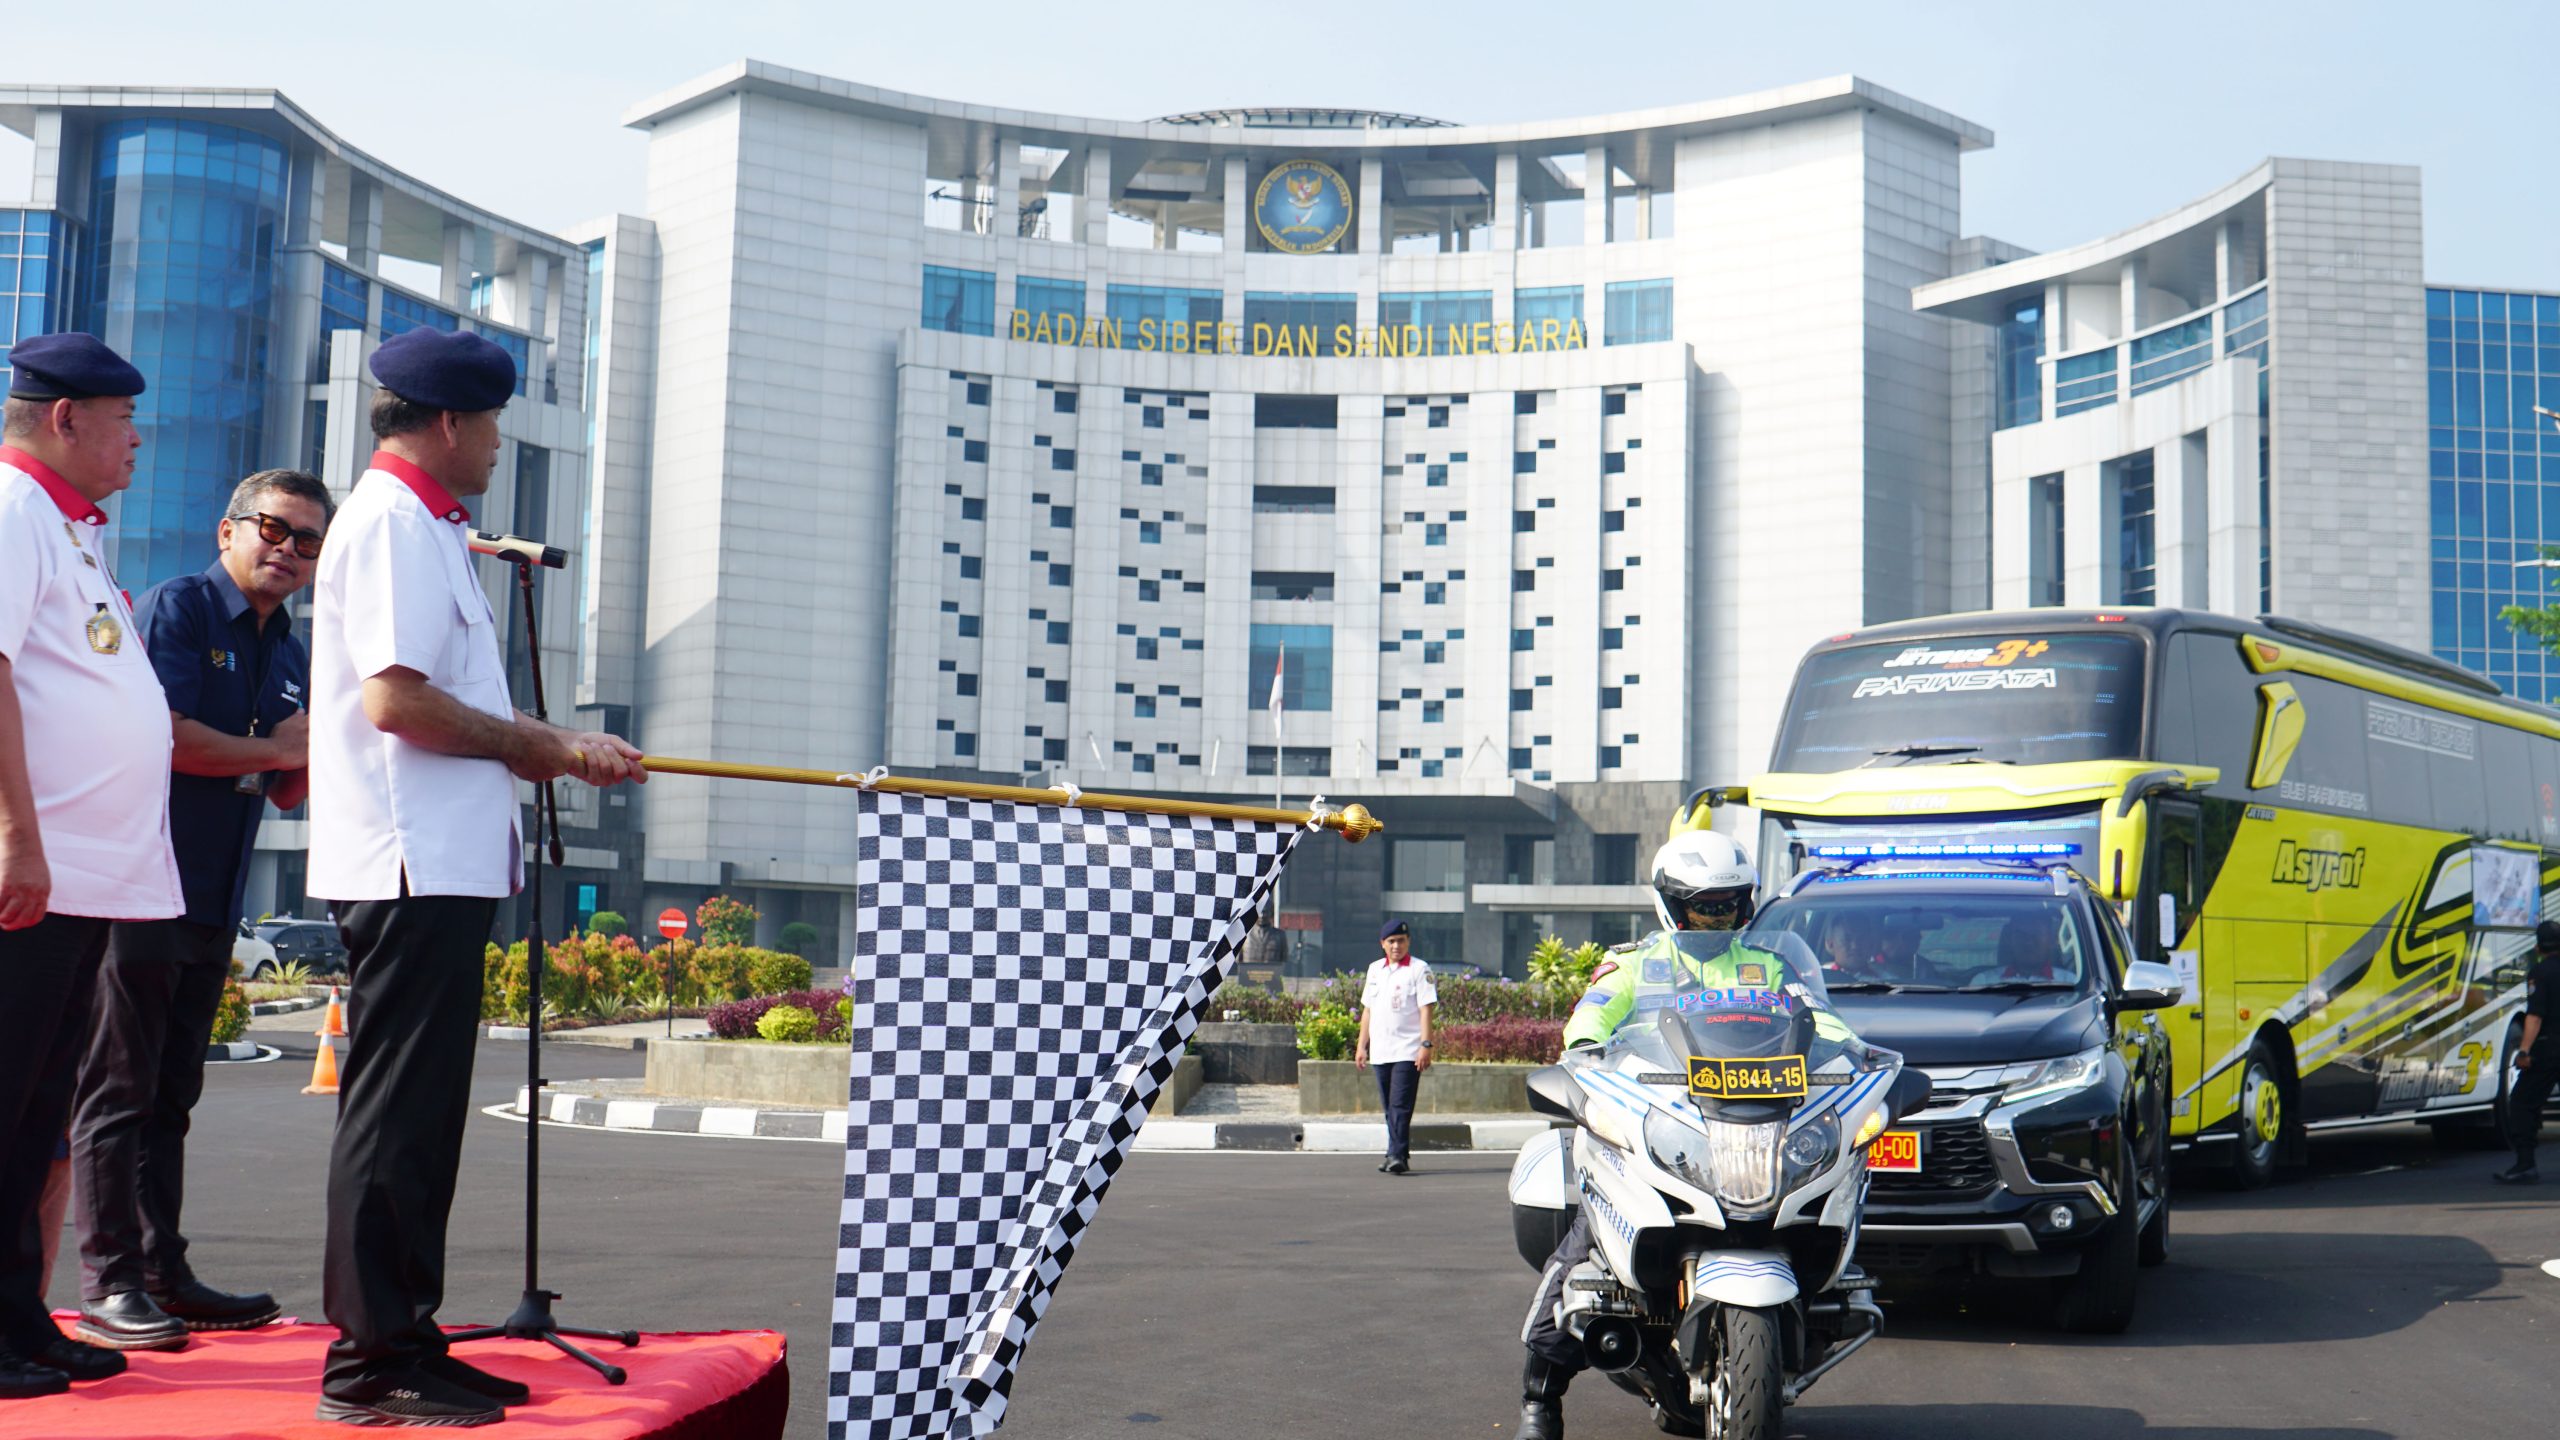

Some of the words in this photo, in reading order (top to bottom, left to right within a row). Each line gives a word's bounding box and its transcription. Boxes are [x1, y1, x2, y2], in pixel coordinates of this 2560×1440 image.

[1011, 309, 1122, 349] BADAN
[1137, 318, 1237, 356] SIBER
[1253, 323, 1318, 357] DAN
[1333, 324, 1434, 358] SANDI
[1449, 318, 1586, 356] NEGARA
[1852, 668, 2058, 698] PARIWISATA
[2272, 838, 2366, 892] Asyrof
[1675, 986, 1793, 1014] POLISI
[1726, 1067, 1802, 1089] 6844-15
[1601, 1146, 1626, 1178] DENWAL
